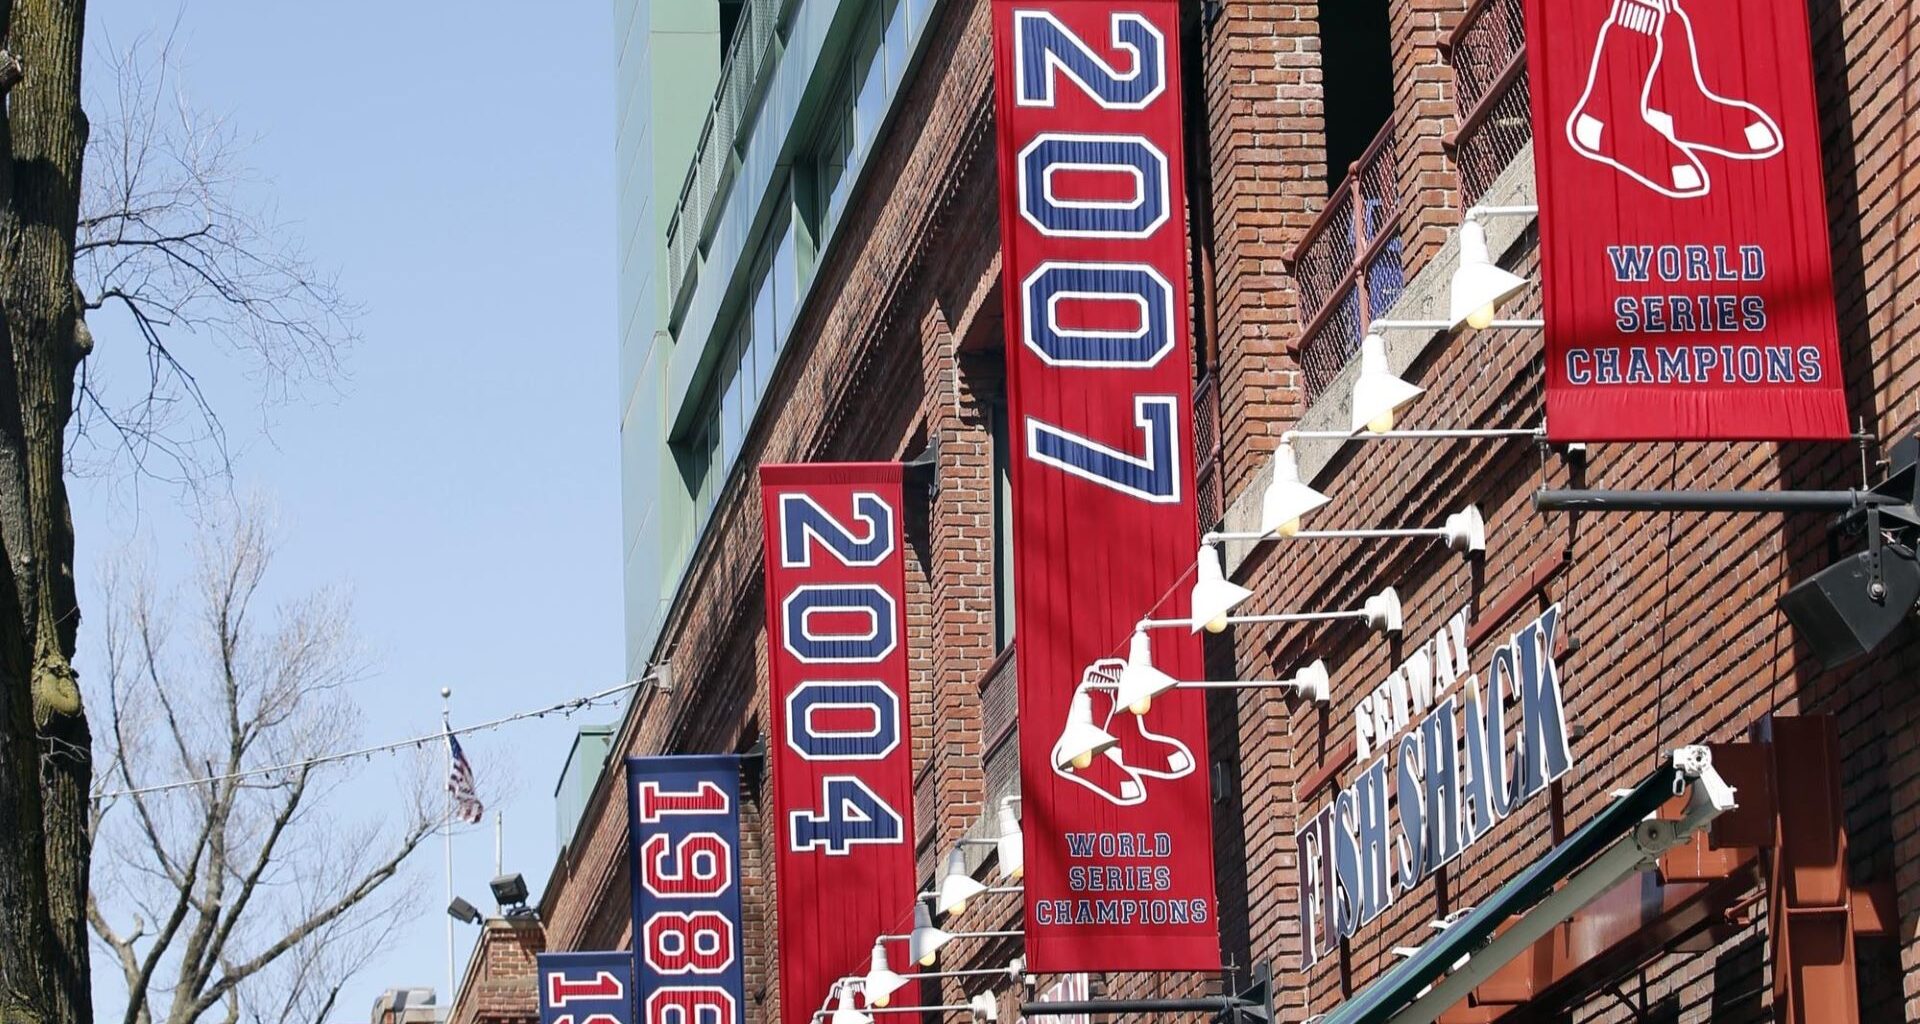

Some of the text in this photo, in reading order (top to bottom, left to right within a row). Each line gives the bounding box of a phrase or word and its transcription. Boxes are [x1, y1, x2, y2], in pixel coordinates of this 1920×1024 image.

[1013, 9, 1181, 503] 2007
[1607, 245, 1765, 282] WORLD
[1615, 295, 1766, 332] SERIES
[1566, 345, 1821, 384] CHAMPIONS
[779, 493, 904, 856] 2004
[1354, 604, 1471, 765] FENWAY
[1296, 602, 1573, 973] FISH SHACK
[1066, 832, 1172, 857] WORLD
[1069, 866, 1171, 891] SERIES
[1036, 898, 1208, 925] CHAMPIONS
